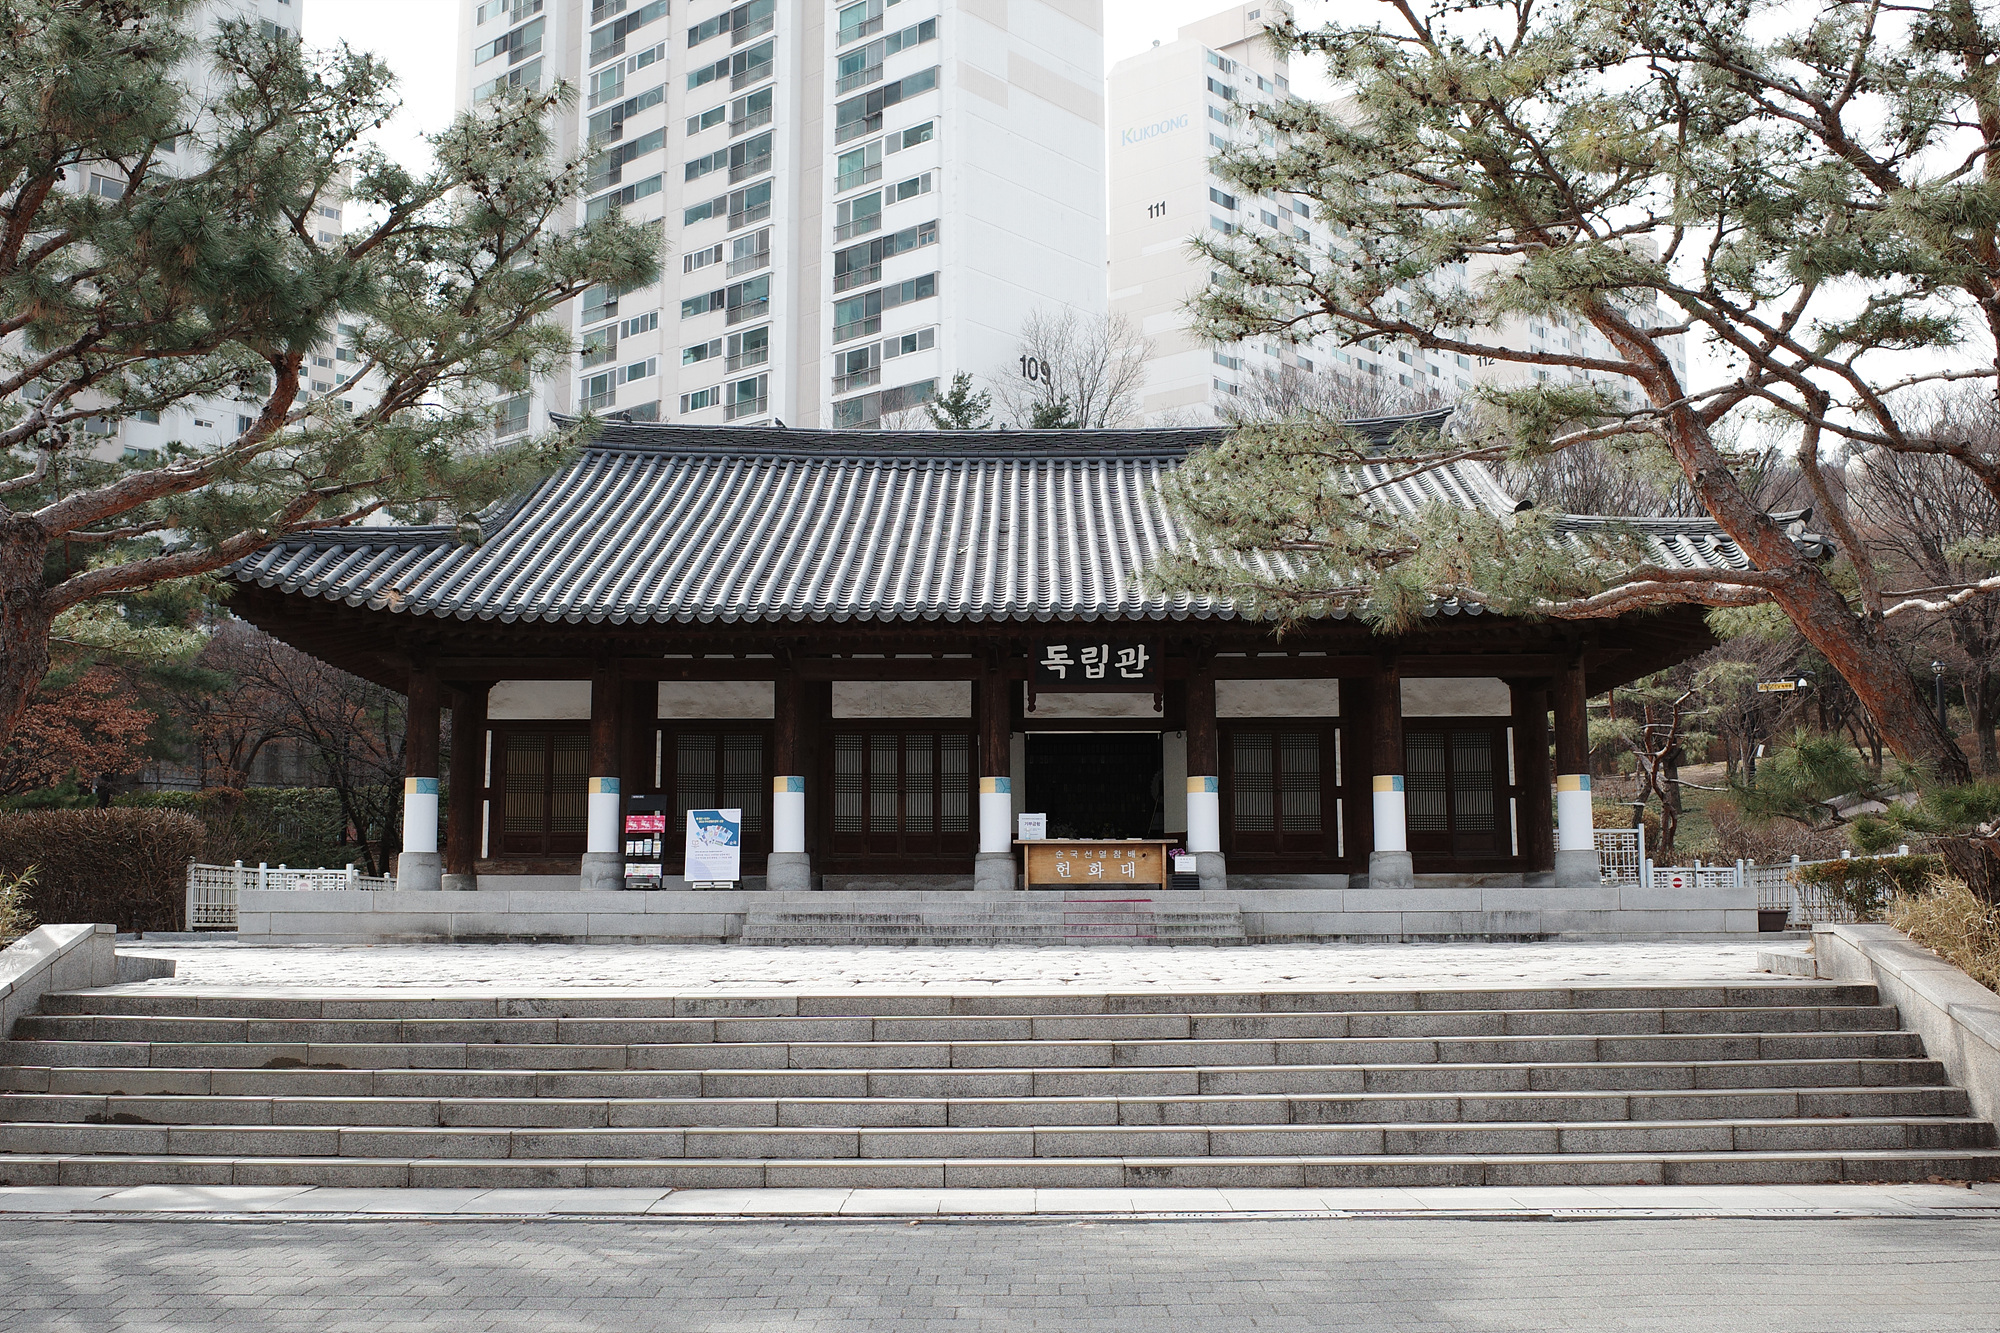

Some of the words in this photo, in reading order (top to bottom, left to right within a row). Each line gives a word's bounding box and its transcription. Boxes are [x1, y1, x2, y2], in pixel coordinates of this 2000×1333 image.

[1147, 201, 1166, 219] 111
[1019, 354, 1051, 385] 109
[1040, 644, 1149, 679] 독립관
